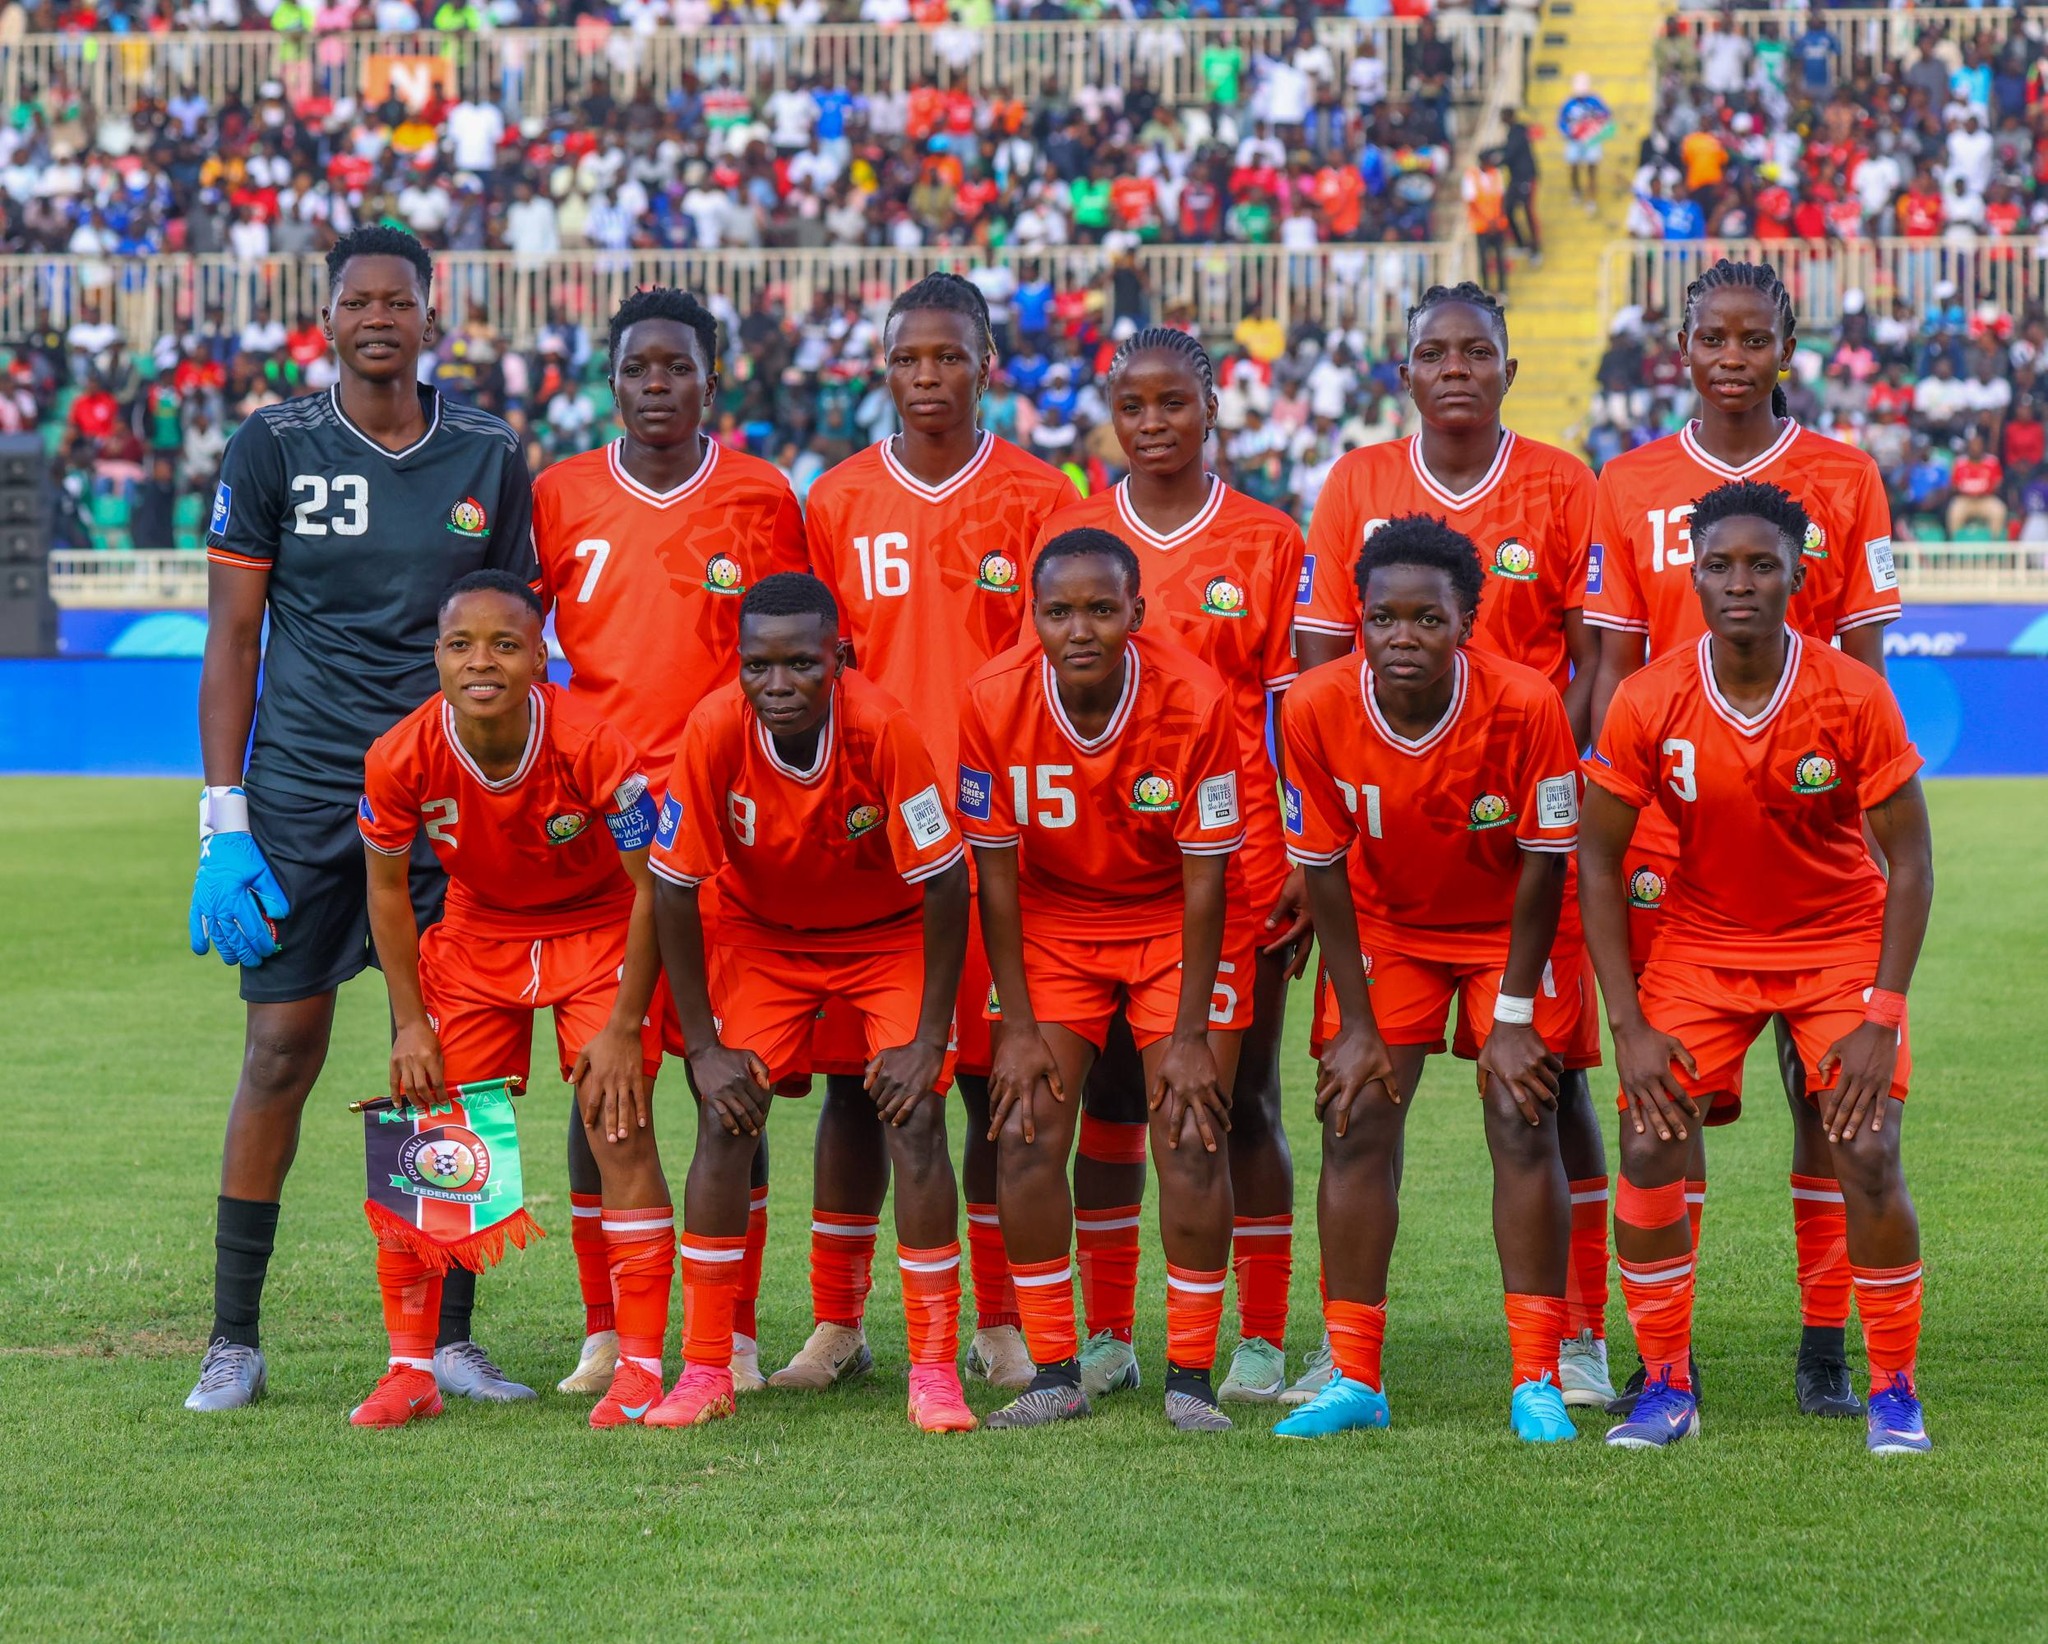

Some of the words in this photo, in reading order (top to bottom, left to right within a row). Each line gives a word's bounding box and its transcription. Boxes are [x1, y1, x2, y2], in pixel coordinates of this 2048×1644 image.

[292, 474, 368, 535] 23
[1647, 504, 1697, 573] 13
[575, 539, 610, 602] 7
[853, 532, 910, 600] 16
[1875, 553, 1892, 565] UNITE
[963, 778, 980, 790] FIFA
[1663, 738, 1697, 802] 3
[961, 783, 985, 800] SERIES
[1009, 764, 1076, 828] 15
[1208, 789, 1231, 802] UNITES
[1547, 790, 1570, 802] UNITES
[421, 797, 458, 849] 2
[607, 809, 645, 830] UNITES
[727, 789, 756, 846] 8
[914, 804, 936, 821] UNITES
[929, 824, 939, 833] FIFA
[378, 1091, 501, 1125] KENYA
[405, 1137, 427, 1182] FOOTBALL
[472, 1143, 488, 1182] KENYA
[413, 1186, 482, 1202] FEDERATION
